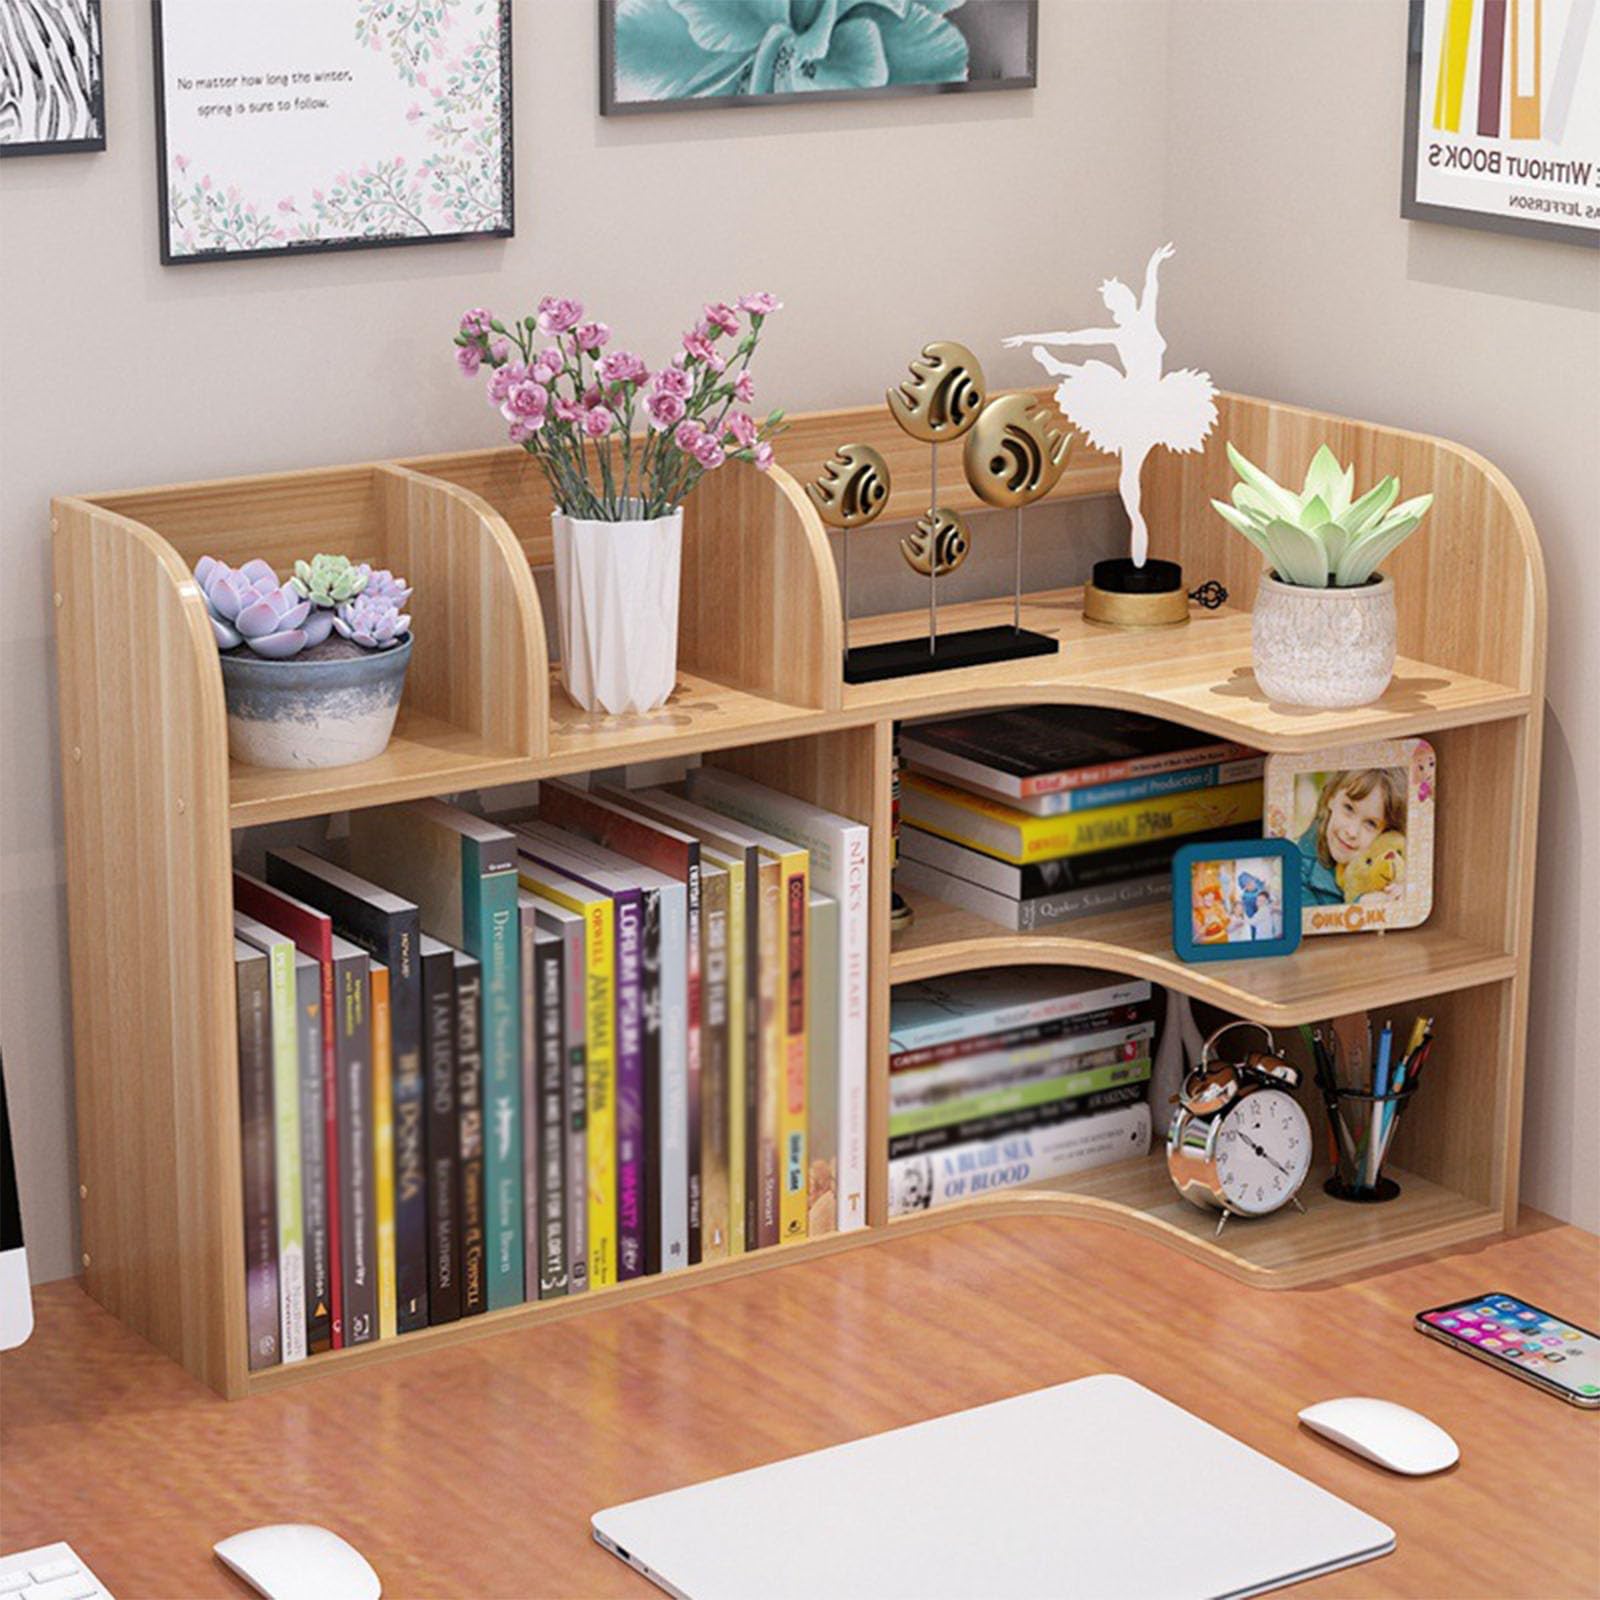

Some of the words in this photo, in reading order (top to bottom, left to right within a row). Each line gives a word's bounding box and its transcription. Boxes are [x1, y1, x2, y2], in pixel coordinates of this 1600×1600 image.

[176, 78, 193, 90] No
[195, 77, 238, 89] matter
[241, 74, 262, 87] how
[266, 73, 288, 88] long
[292, 72, 311, 84] the
[197, 104, 232, 118] spring
[235, 102, 246, 114] is
[248, 101, 274, 114] sure
[277, 100, 290, 112] to
[1151, 774, 1200, 792] Production
[1075, 816, 1130, 846] ANIMAL
[849, 840, 865, 912] NICK'S
[491, 910, 510, 993] Dreaming
[592, 908, 603, 966] ORWELL
[620, 902, 638, 981] LORUM
[590, 974, 609, 1050] ANIMAL
[849, 953, 862, 1020] HEART
[433, 1005, 449, 1038] AM
[544, 1008, 560, 1036] FOR
[433, 1041, 452, 1114] LEGEND
[546, 1192, 561, 1219] FOR
[621, 1163, 637, 1229] WHAT?
[764, 1177, 777, 1227] Stewart
[971, 1163, 1031, 1193] BLOOD
[315, 1230, 325, 1297] Education
[353, 1217, 366, 1286] Insecurity
[546, 1221, 562, 1273] GLORY!
